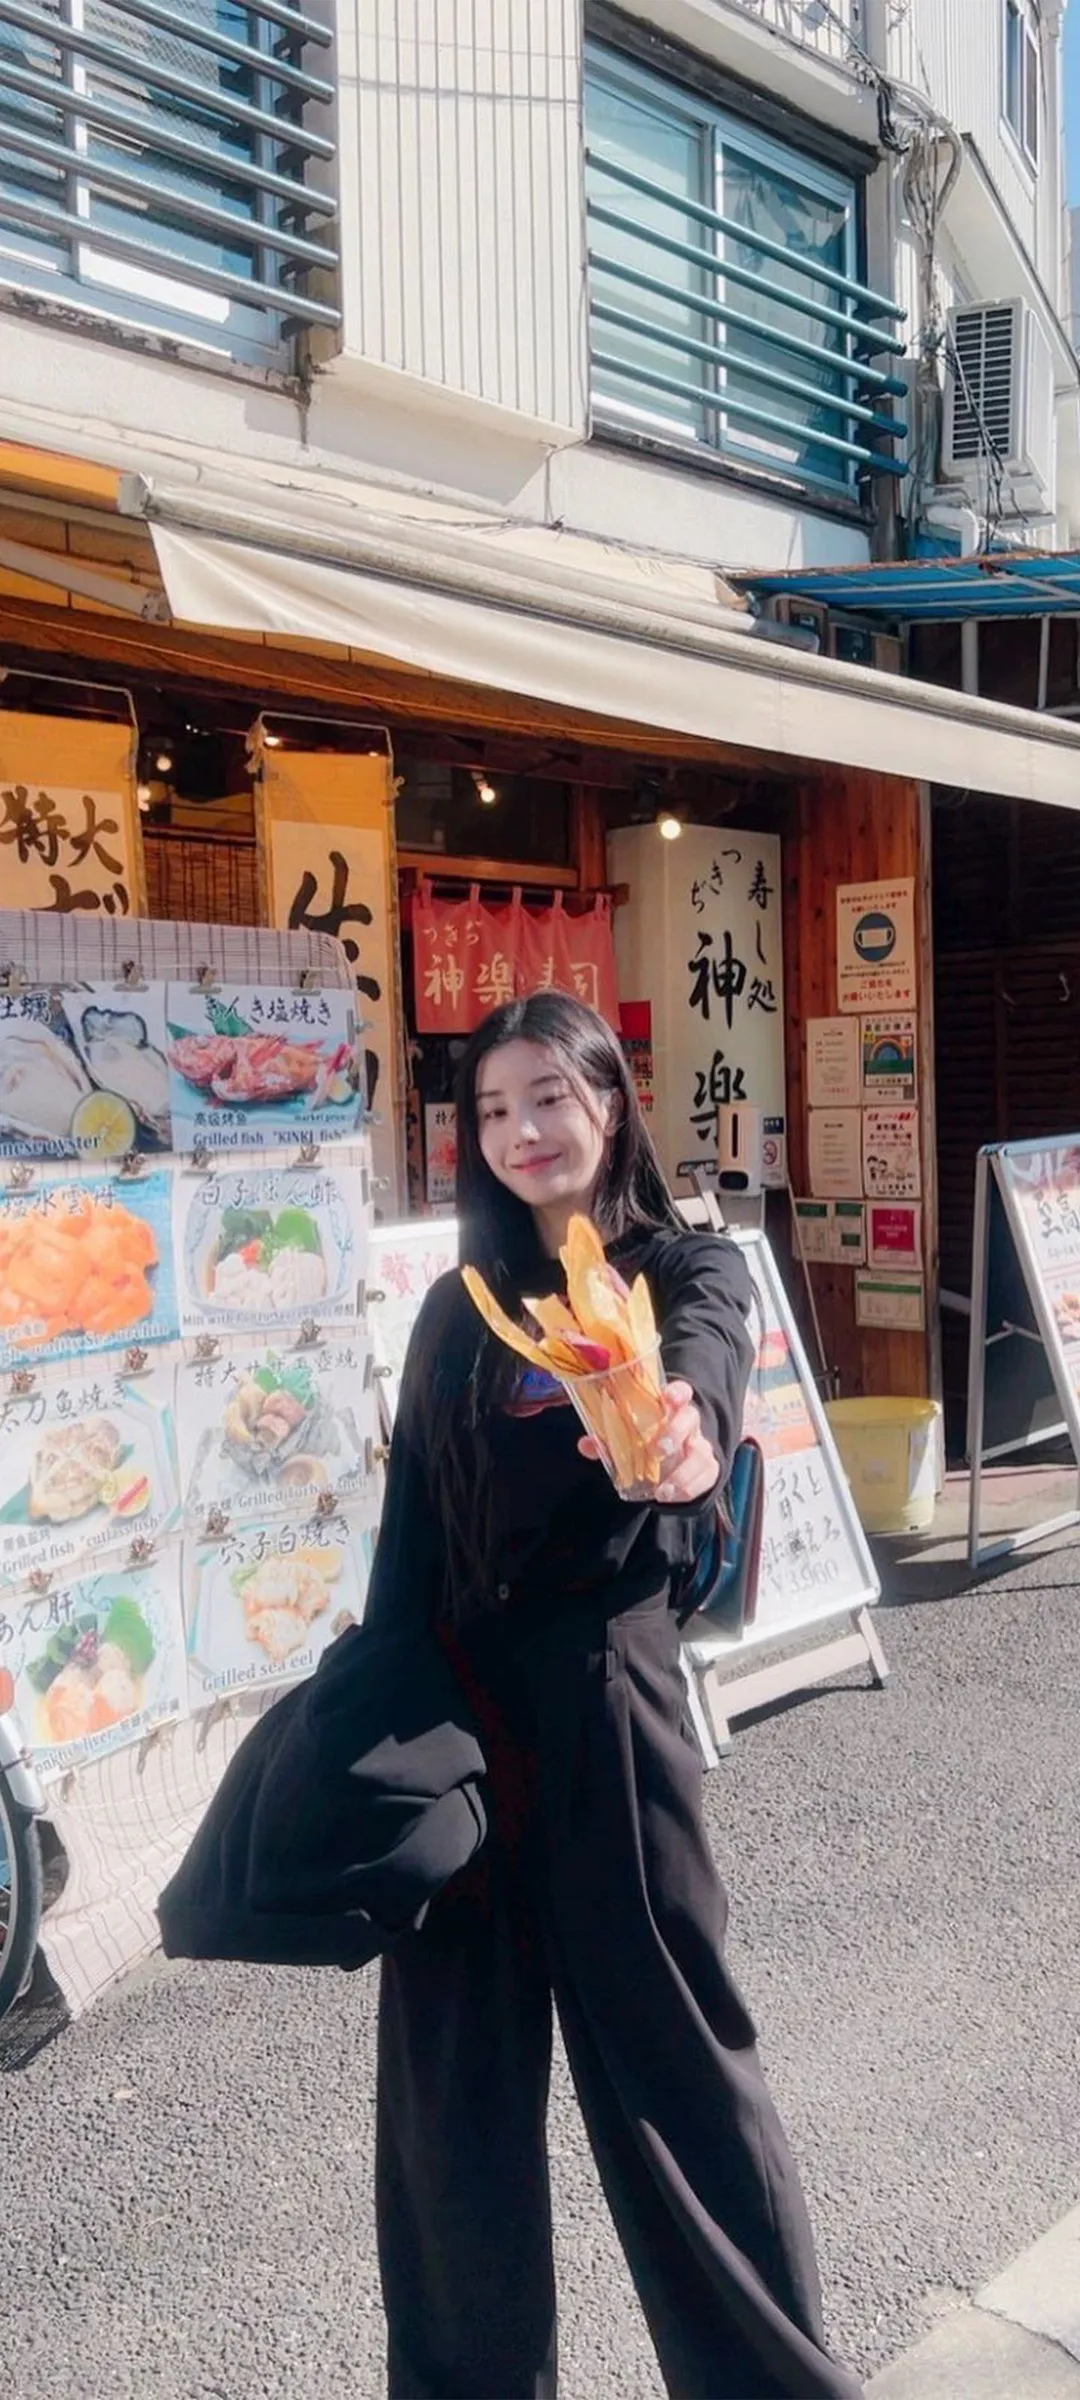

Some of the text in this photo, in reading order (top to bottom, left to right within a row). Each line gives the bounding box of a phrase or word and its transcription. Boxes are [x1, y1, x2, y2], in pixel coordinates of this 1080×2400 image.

[748, 861, 779, 1014] 寿し処
[193, 1132, 238, 1147] Grilled
[241, 1132, 264, 1145] fish
[2, 1550, 47, 1575] Grilled
[50, 1541, 76, 1561] fish
[220, 1519, 352, 1567] 穴子白焼き
[202, 1649, 314, 1692] Grilled sea eel
